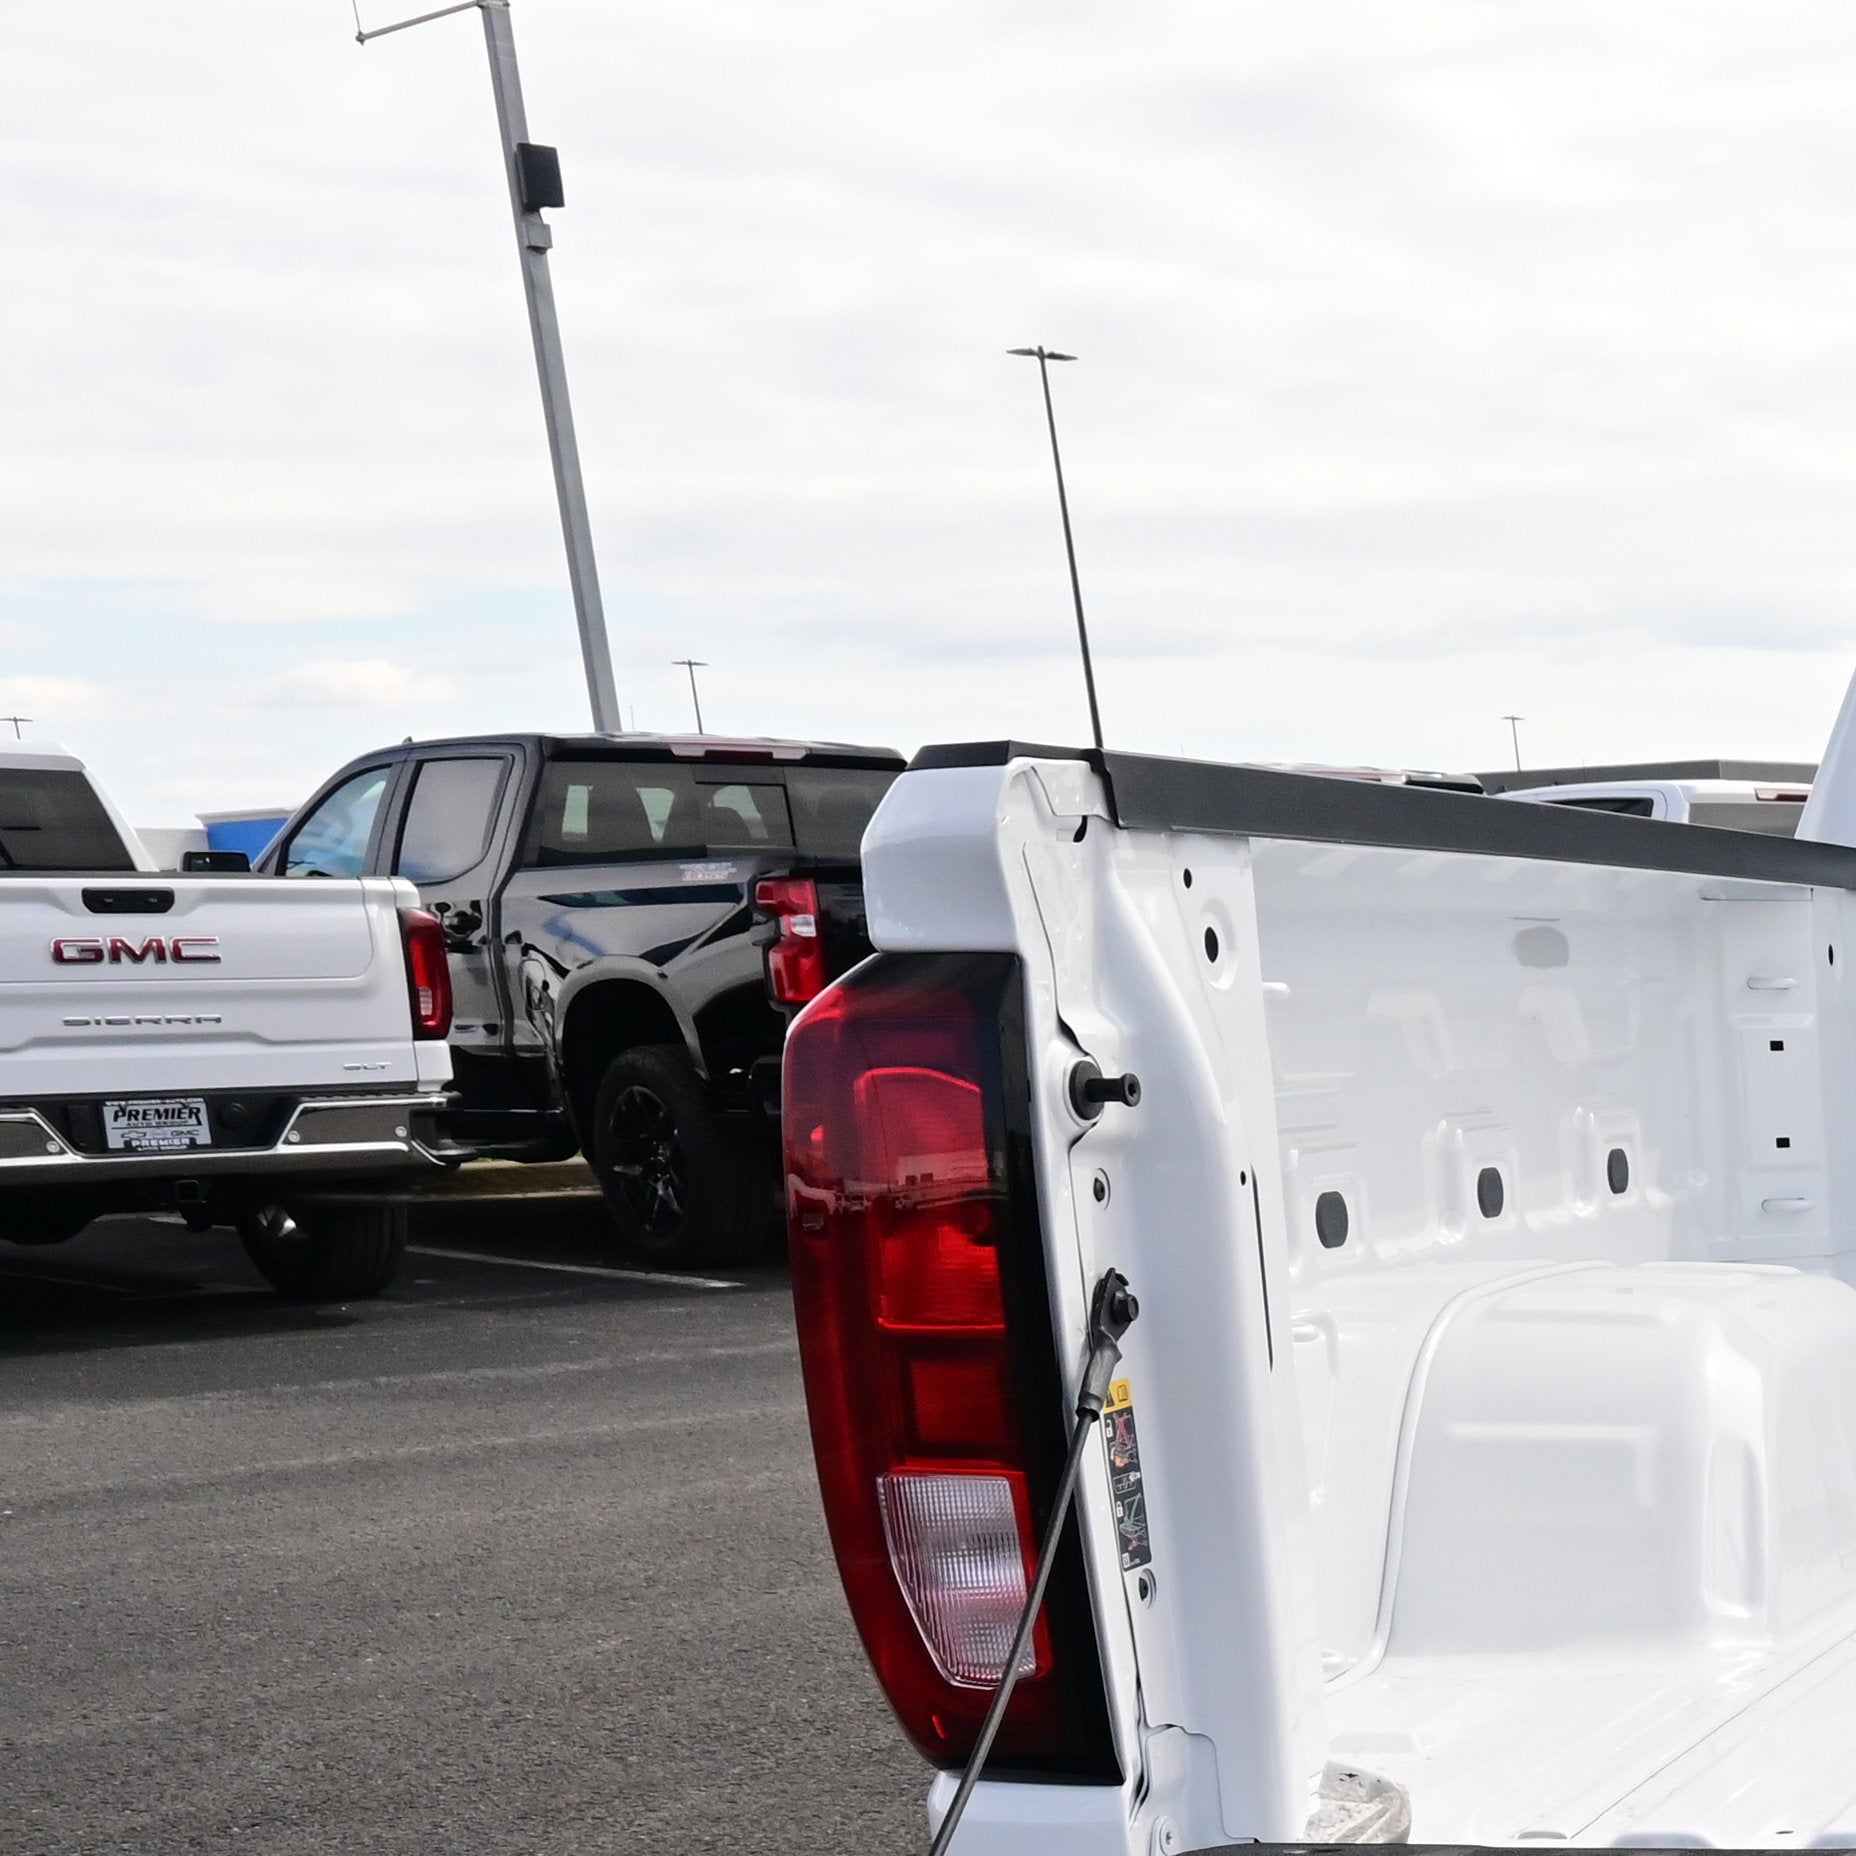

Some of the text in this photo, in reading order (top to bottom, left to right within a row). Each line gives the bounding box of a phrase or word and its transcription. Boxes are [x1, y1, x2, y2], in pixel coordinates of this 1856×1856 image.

[51, 936, 222, 966] GMC
[62, 1014, 222, 1027] SIERRA
[113, 1107, 203, 1126] PREMIER
[131, 1138, 190, 1147] PREMIER
